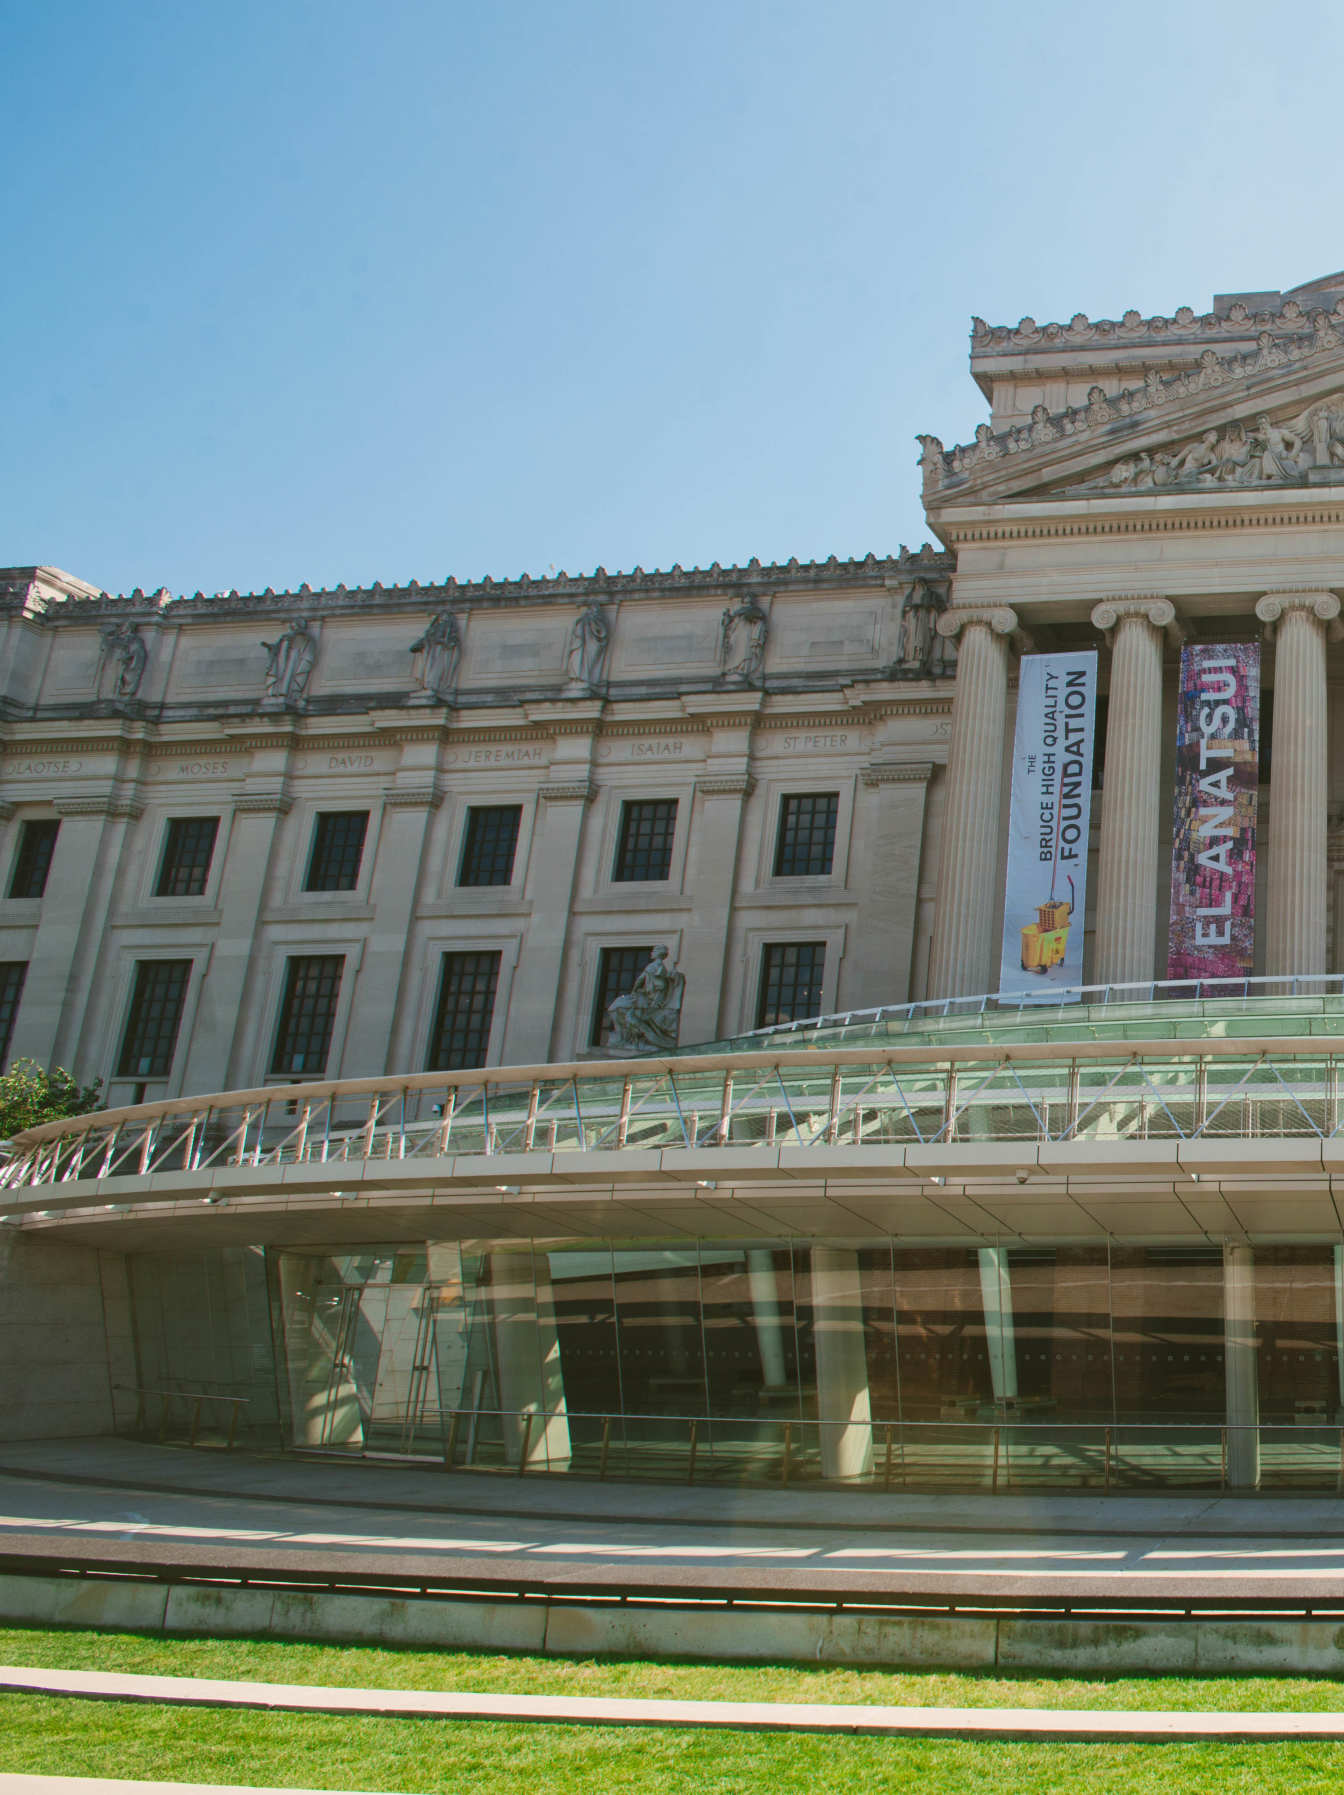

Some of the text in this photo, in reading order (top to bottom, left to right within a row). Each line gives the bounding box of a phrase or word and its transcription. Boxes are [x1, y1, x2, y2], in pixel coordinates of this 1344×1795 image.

[804, 734, 848, 748] PETER
[463, 748, 542, 763] JEREMIAH
[631, 742, 684, 756] ISAIAH
[177, 761, 229, 776] MOSES
[328, 755, 375, 769] DAVID
[1027, 753, 1037, 776] THE
[1040, 672, 1059, 862] BRUCE HIGH QUALITY
[1060, 670, 1087, 861] FOUNDATION
[1195, 659, 1237, 945] EL ANATSUI
